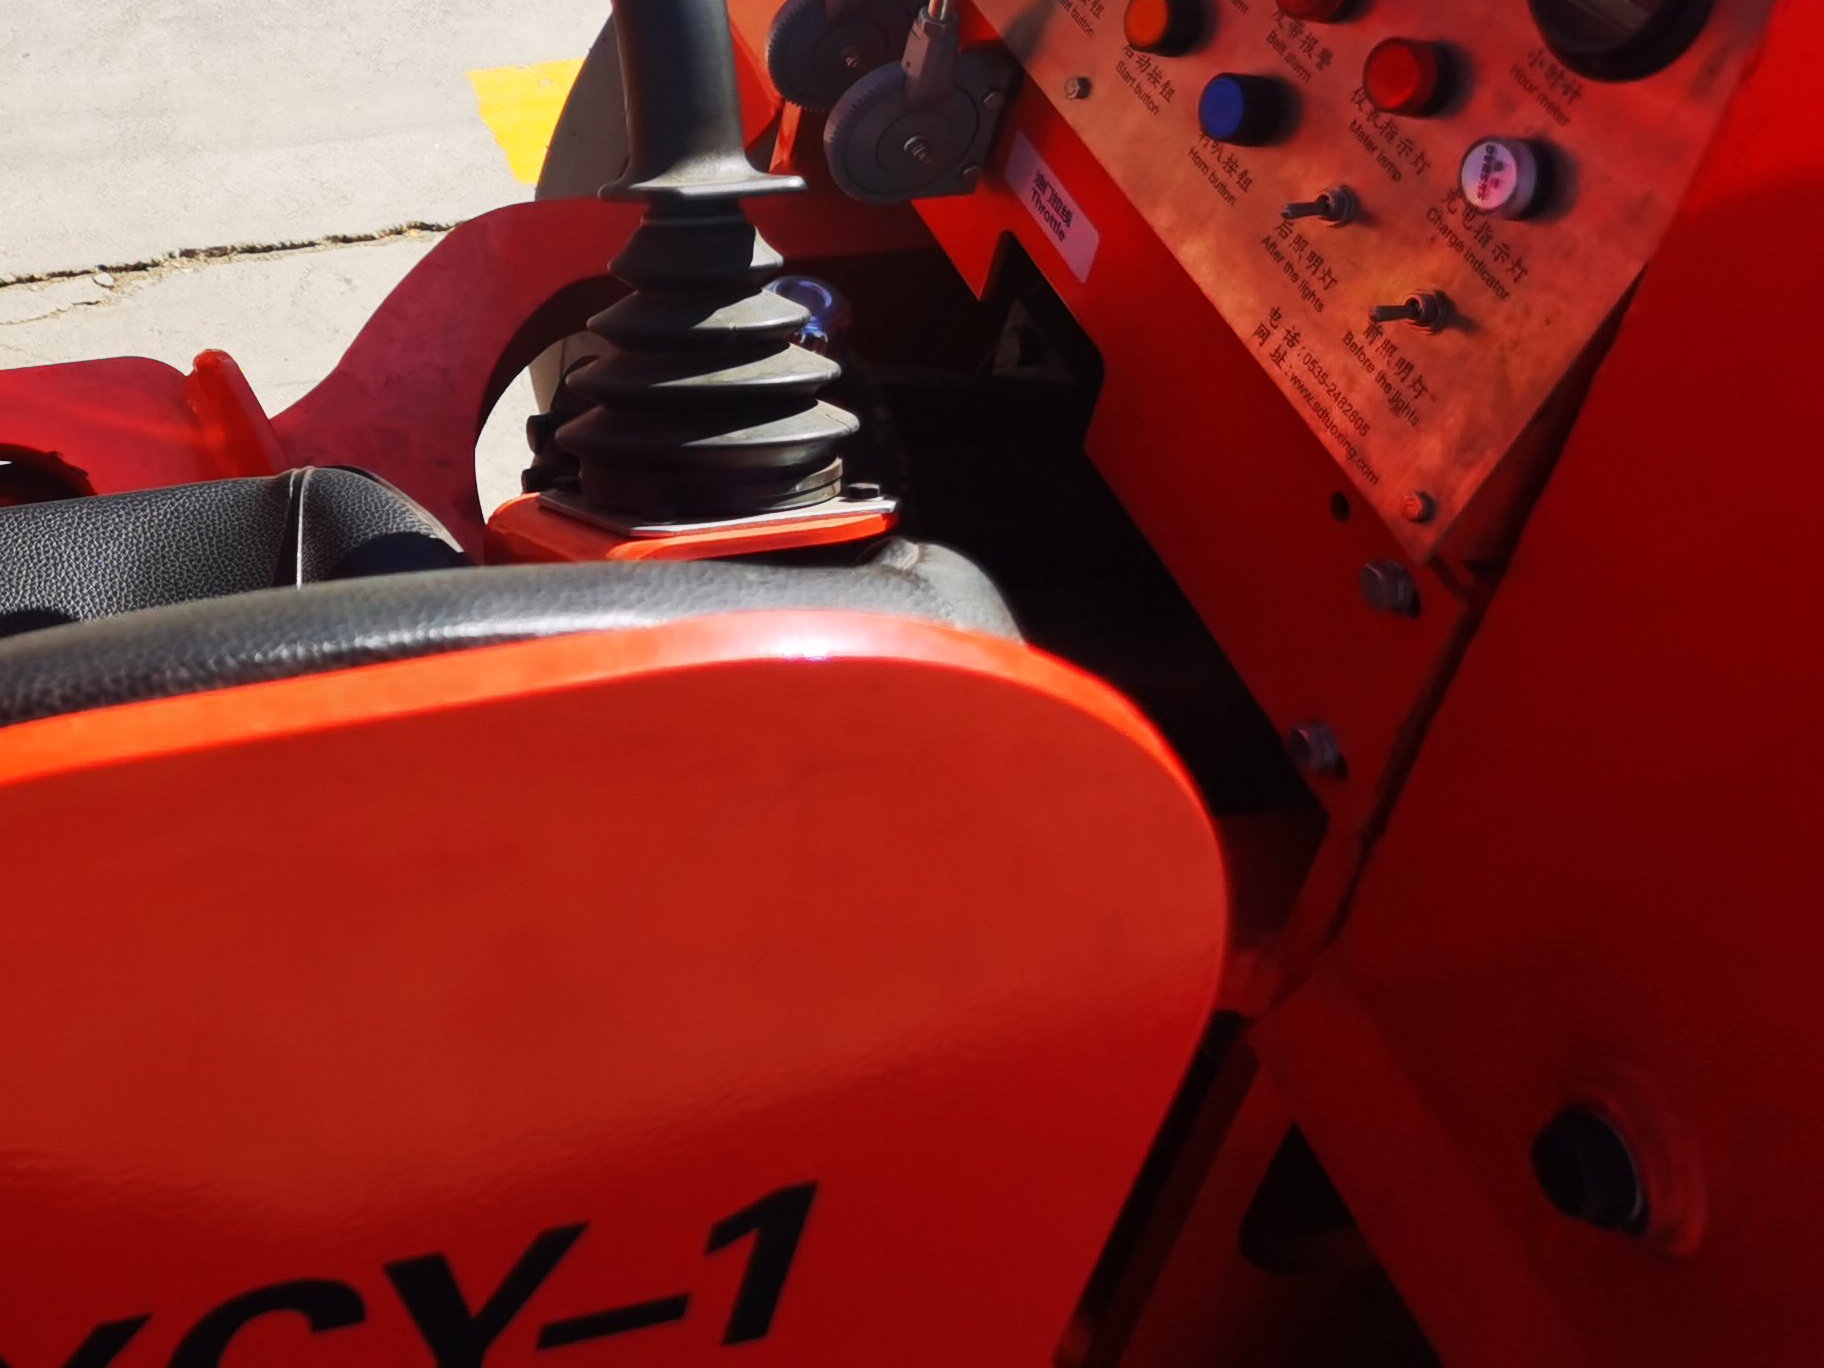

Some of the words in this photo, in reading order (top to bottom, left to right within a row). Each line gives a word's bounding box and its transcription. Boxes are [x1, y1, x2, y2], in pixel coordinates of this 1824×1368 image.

[1071, 6, 1096, 40] button
[1115, 60, 1137, 88] Start
[1133, 81, 1161, 117] button
[1284, 52, 1312, 83] alarm
[1509, 62, 1538, 94] Hour
[1535, 92, 1571, 128] meter
[1527, 48, 1584, 106] 小时计
[1187, 146, 1210, 176] Horn
[1207, 170, 1237, 207] button
[1348, 119, 1378, 153] Meter
[1375, 148, 1402, 182] lamp
[1030, 186, 1066, 243] Throttle
[1261, 235, 1286, 264] After
[1282, 259, 1300, 284] the
[1297, 277, 1325, 314] lights
[1273, 219, 1339, 292] 后照明灯
[1426, 206, 1465, 252] Charge
[1463, 246, 1511, 300] indicator
[1341, 330, 1376, 375] Before
[1374, 369, 1394, 395] the
[1388, 389, 1421, 428] lights
[1362, 320, 1429, 401] 前照明灯
